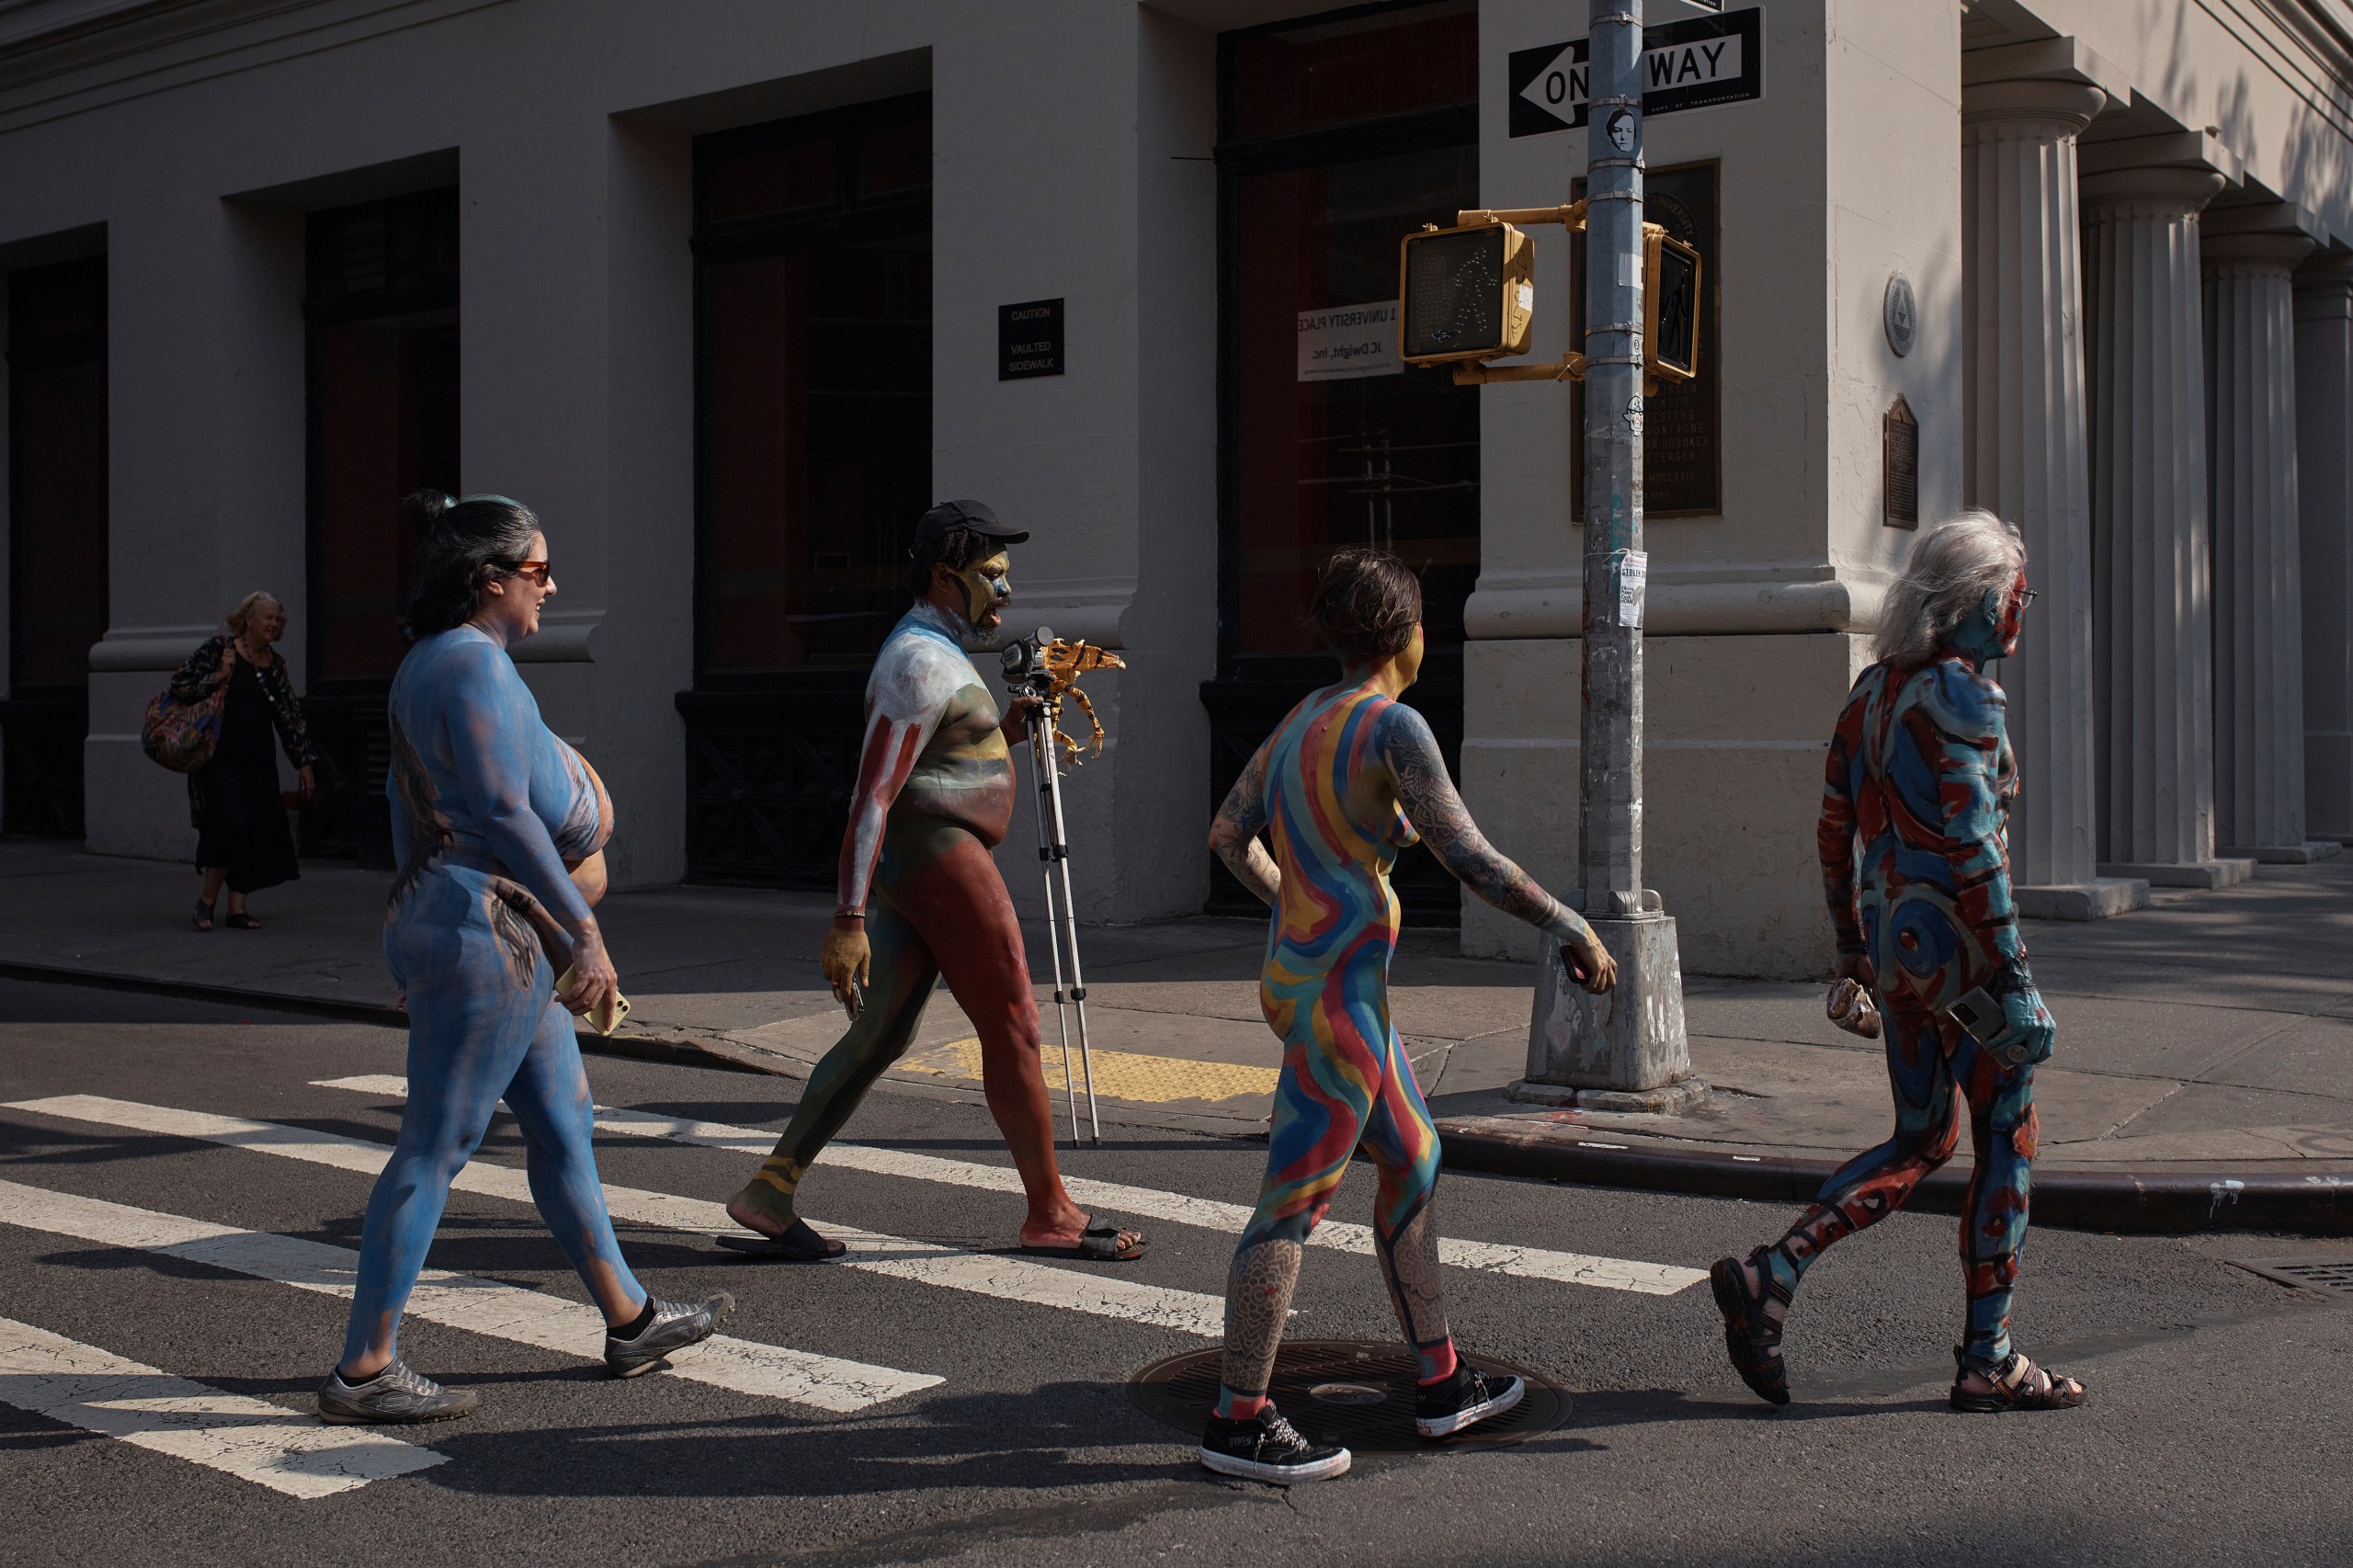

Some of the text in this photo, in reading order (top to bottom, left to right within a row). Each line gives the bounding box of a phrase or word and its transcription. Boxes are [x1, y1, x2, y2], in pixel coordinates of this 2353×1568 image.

[1545, 42, 1726, 105] ON WAY
[1690, 92, 1750, 106] TRANSPORTATION
[1654, 194, 1695, 235] UNIVERSITY
[1011, 307, 1051, 321] CAUTION
[1011, 342, 1051, 354] VAULTED
[1009, 358, 1053, 371] SIDEWALK
[1644, 436, 1710, 449] AN HOBOKEN
[1646, 450, 1696, 463] ETERSEN
